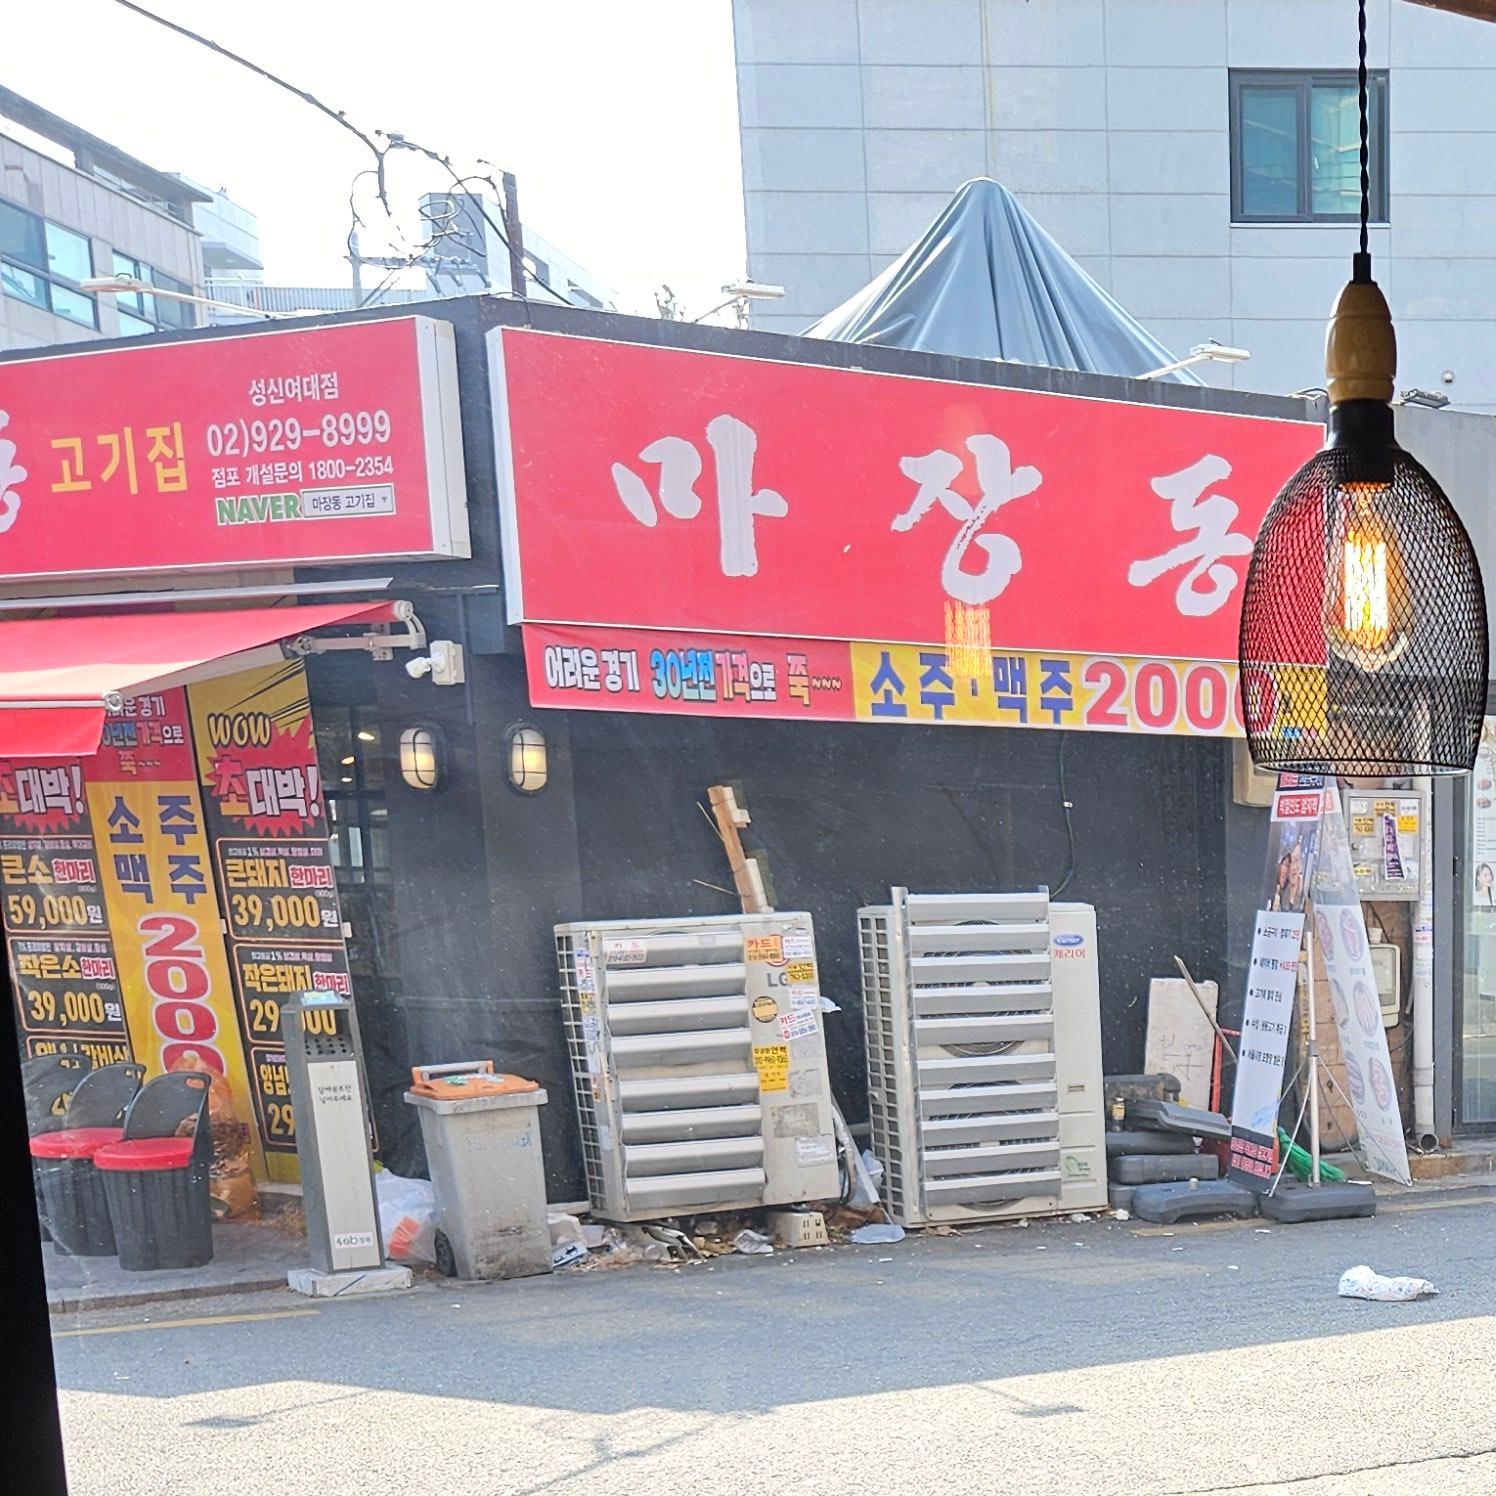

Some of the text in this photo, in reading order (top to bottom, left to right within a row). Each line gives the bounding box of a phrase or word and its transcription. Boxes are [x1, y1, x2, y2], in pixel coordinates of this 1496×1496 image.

[249, 372, 340, 406] 성신여대점
[207, 410, 391, 458] 02)929-8999
[51, 421, 189, 495] 고기집
[212, 456, 394, 489] 점포 개설문의 1800-2354
[216, 493, 301, 525] NAVER
[311, 493, 376, 512] 마장동 고기집
[612, 414, 1256, 618] 마장동
[545, 646, 601, 691] 어려운
[601, 648, 641, 693] 경기
[138, 695, 165, 717] 경기
[993, 656, 1073, 724] 맥주
[207, 712, 273, 747] WOW
[212, 754, 323, 818] 초대박!
[0, 854, 95, 885] 큰소 한마리
[225, 858, 333, 888] 큰돼지 한마리
[7, 894, 104, 930] 59,000원
[232, 894, 339, 932] 39,000원
[17, 953, 114, 979] 작은소 한마리
[1054, 948, 1086, 960] 캐리어
[242, 963, 313, 993] 작은돼지
[27, 990, 122, 1027] 39,000원
